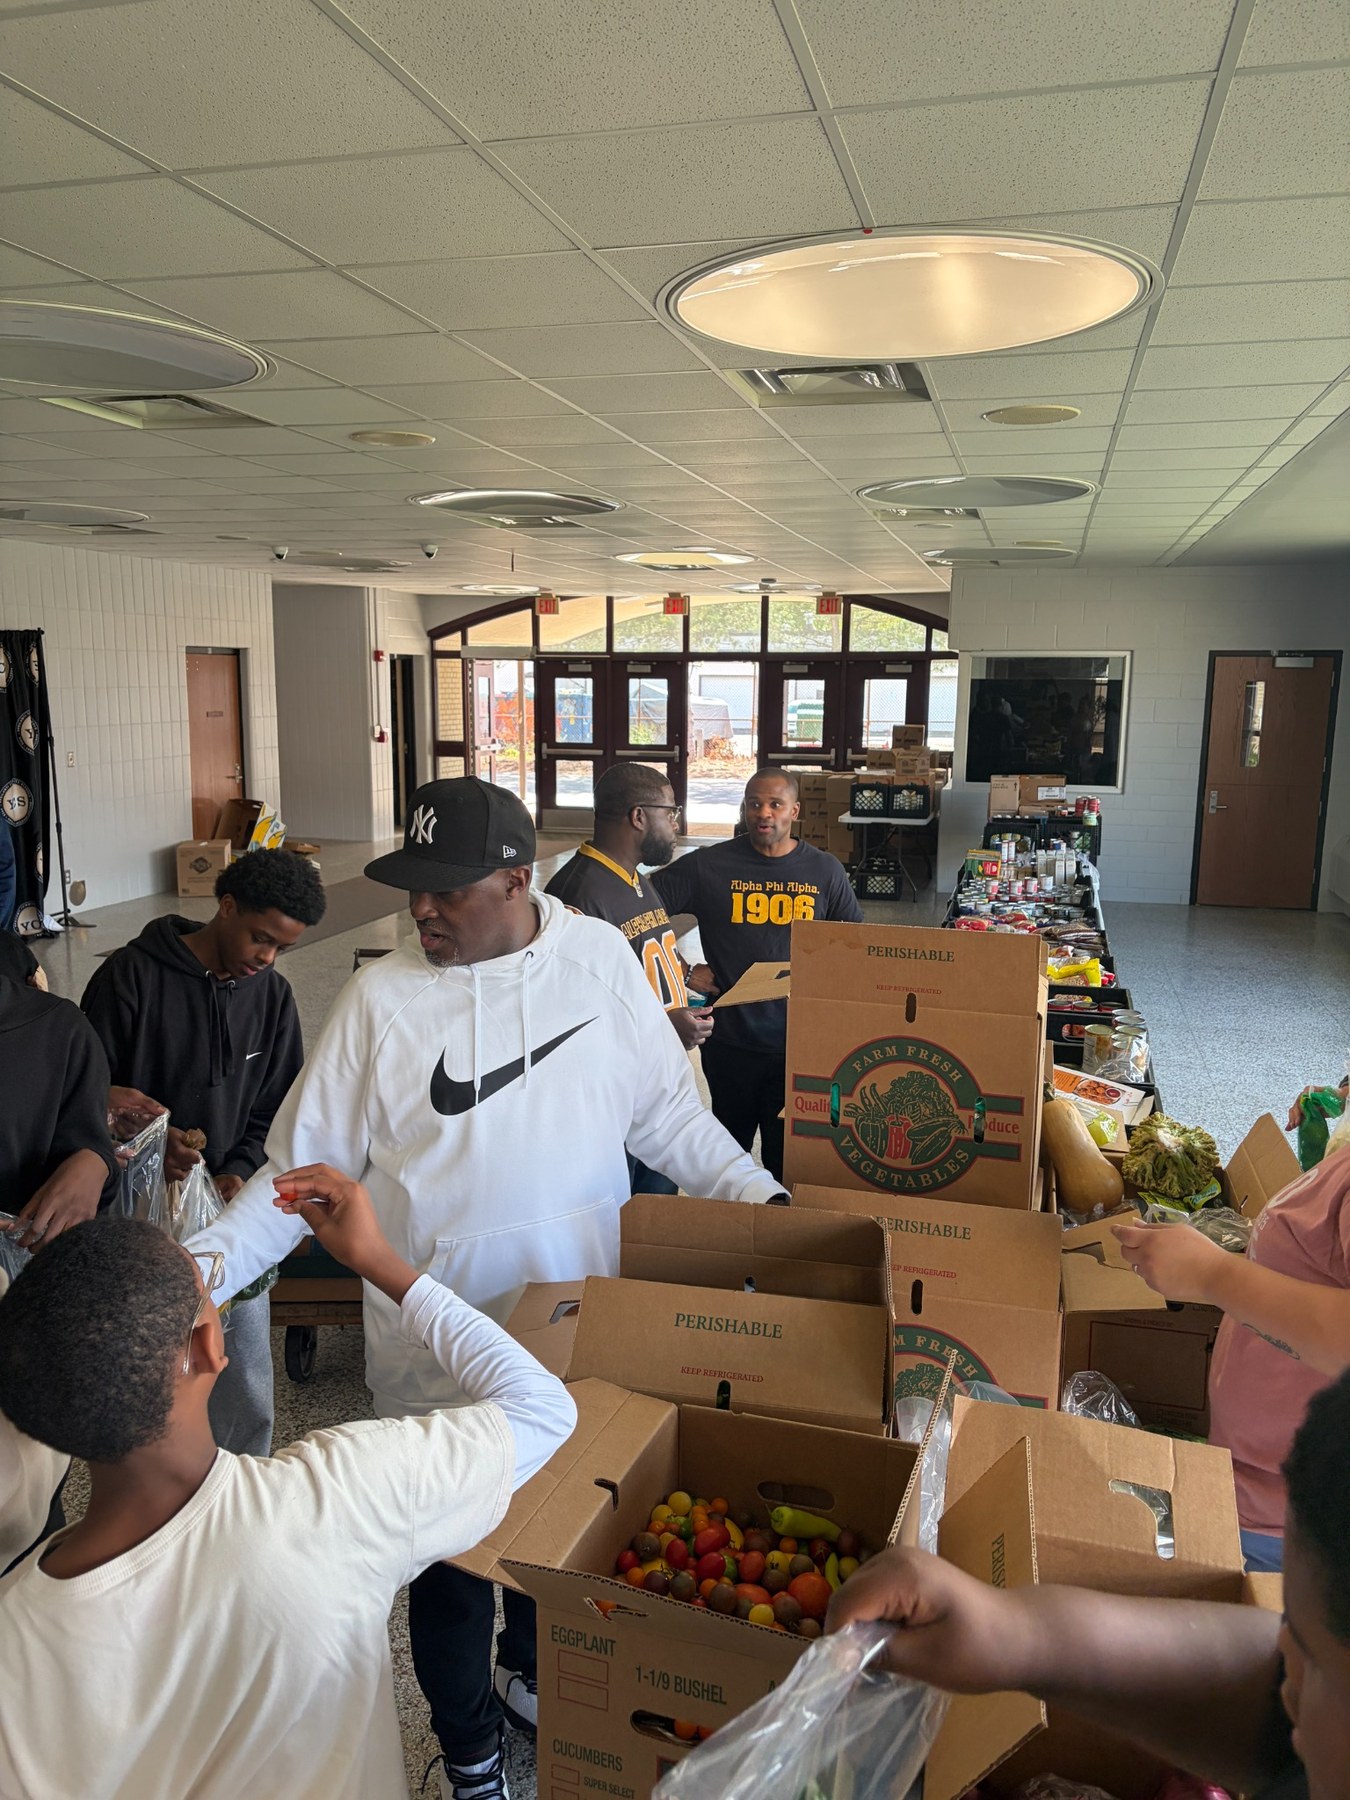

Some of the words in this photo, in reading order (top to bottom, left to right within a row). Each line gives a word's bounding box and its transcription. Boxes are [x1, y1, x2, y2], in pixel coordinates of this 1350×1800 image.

[820, 599, 838, 613] EXIT
[730, 880, 763, 893] Alpha
[765, 881, 784, 892] Phi
[731, 892, 815, 925] 1906
[867, 945, 955, 963] PERISHABLE
[893, 985, 942, 995] REFRIGERATED
[852, 1045, 898, 1072] FARM
[906, 1045, 963, 1083] FRESH
[840, 1135, 969, 1188] VEGETABLES
[902, 1265, 957, 1279] REFRIGERATED
[674, 1312, 783, 1339] PERISHABLE
[915, 1335, 978, 1378] FRESH
[680, 1366, 702, 1376] KEEP
[702, 1368, 764, 1383] REFRIGERATED
[551, 1624, 617, 1657] EGGPLANT
[635, 1665, 670, 1691] 1-1/9
[674, 1675, 727, 1705] BUSHEL
[552, 1738, 623, 1772] CUCUMBERS
[583, 1776, 608, 1792] SUPER
[608, 1783, 636, 1800] SELECT
